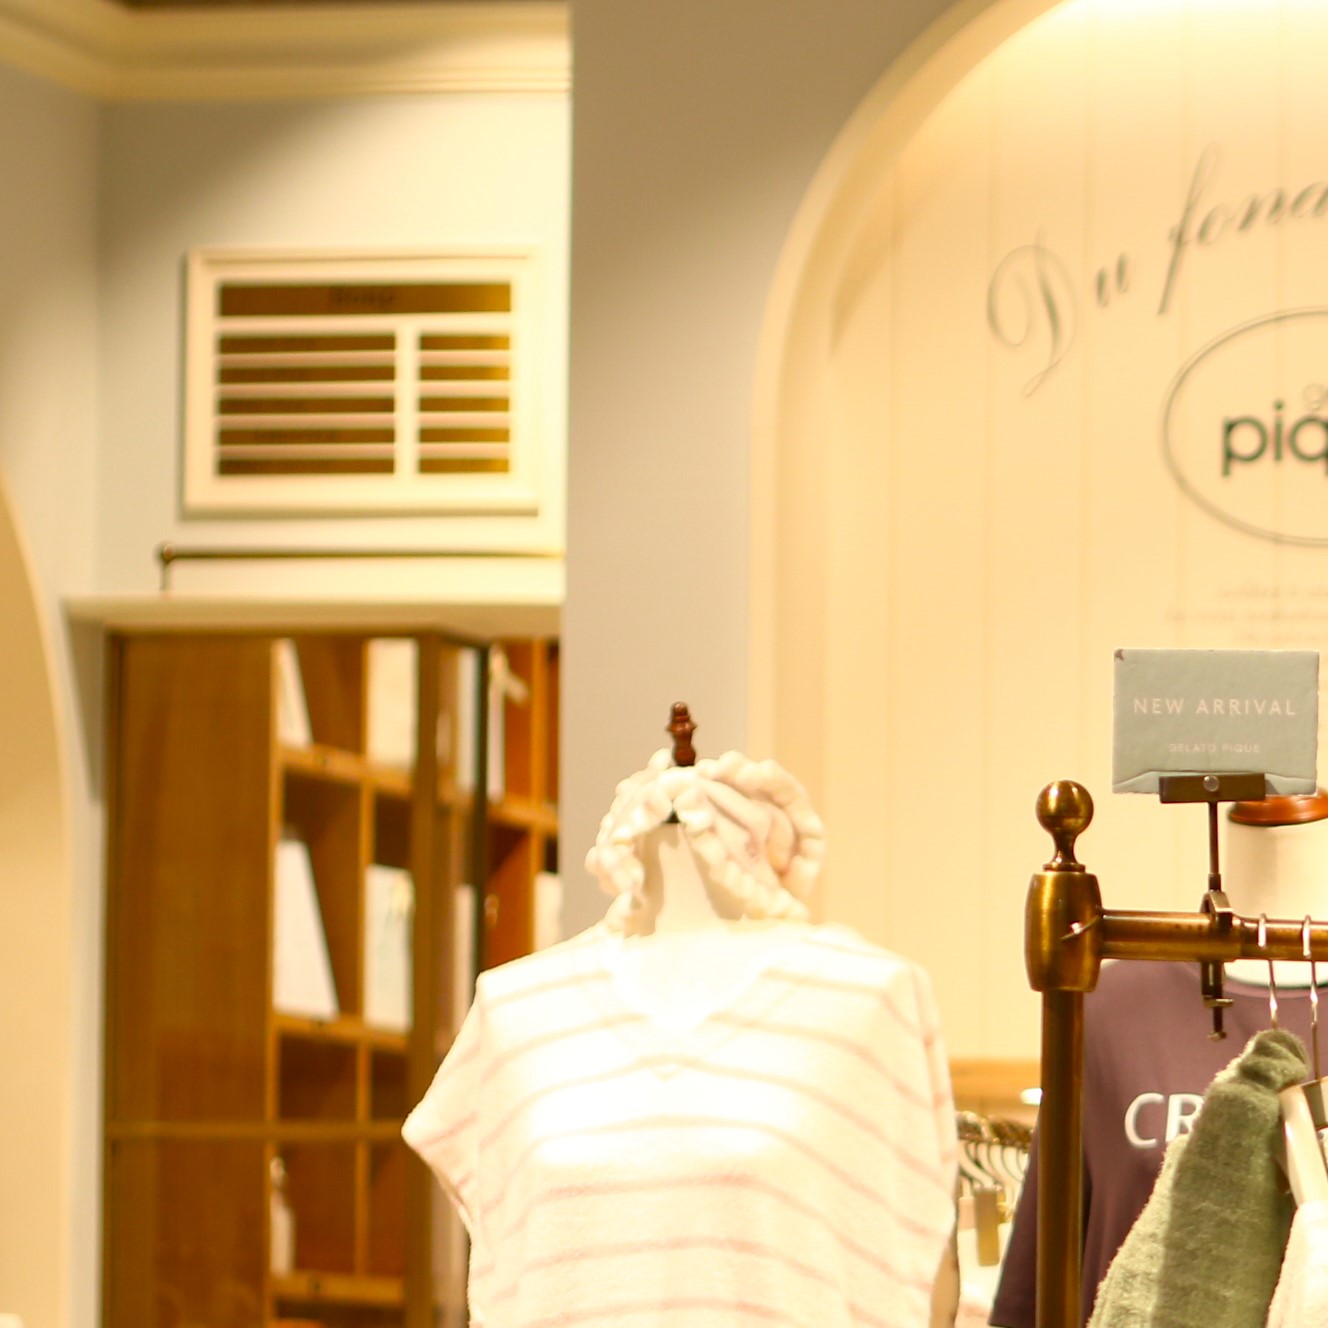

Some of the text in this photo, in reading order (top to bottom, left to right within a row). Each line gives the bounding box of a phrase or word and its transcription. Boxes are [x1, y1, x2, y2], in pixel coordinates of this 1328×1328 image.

[984, 229, 1132, 398] Du
[1133, 697, 1297, 717] NEW ARRIVAL
[1169, 743, 1260, 754] GELATO PIQUE
